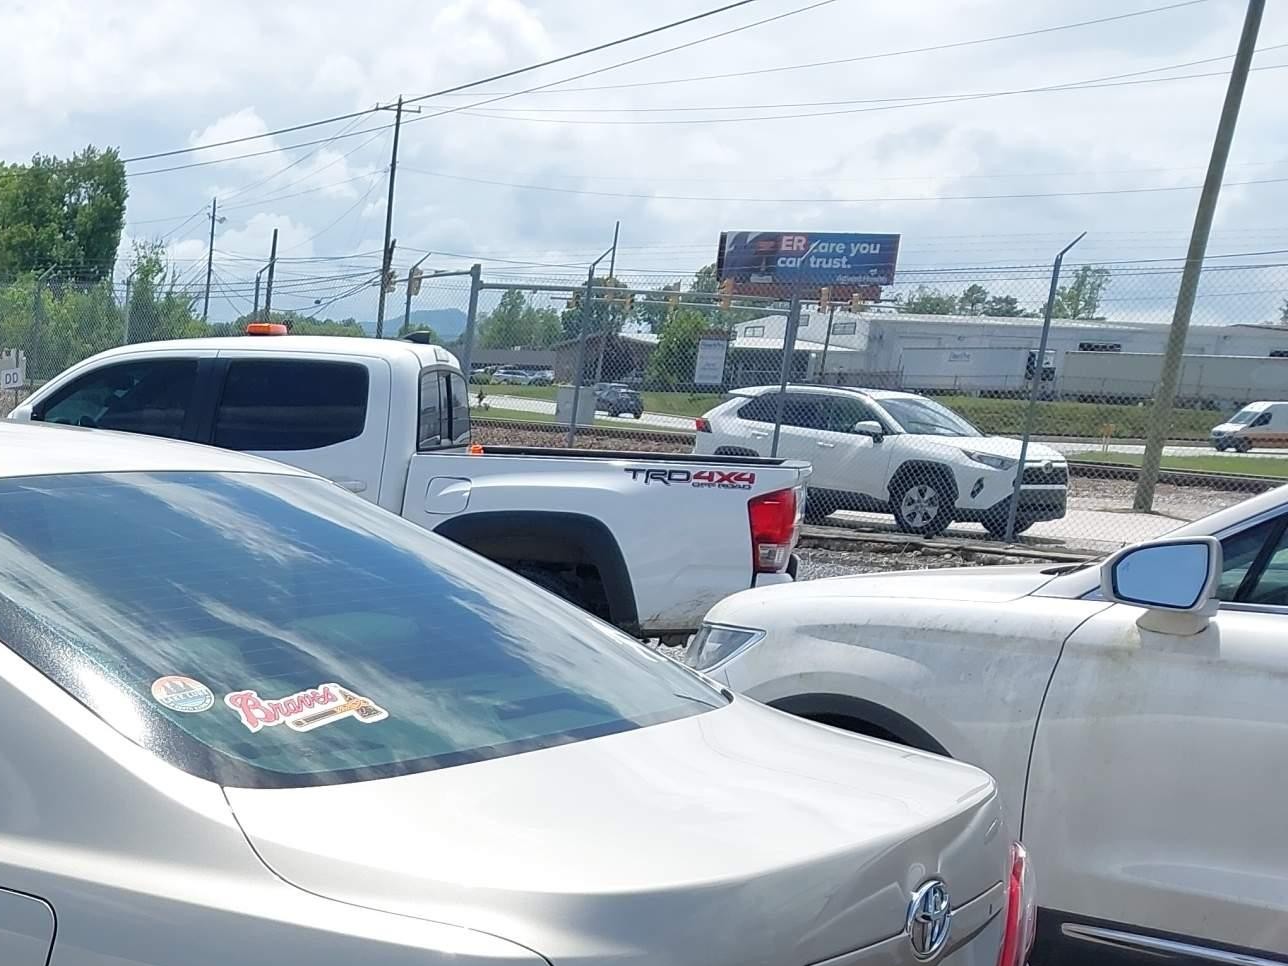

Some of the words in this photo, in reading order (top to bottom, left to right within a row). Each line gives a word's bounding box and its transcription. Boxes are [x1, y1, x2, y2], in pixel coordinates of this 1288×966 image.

[781, 235, 807, 251] ER
[850, 243, 881, 257] you
[809, 255, 852, 269] trust.
[5, 372, 19, 385] DD
[624, 468, 691, 485] TRD
[229, 687, 337, 728] Braves
